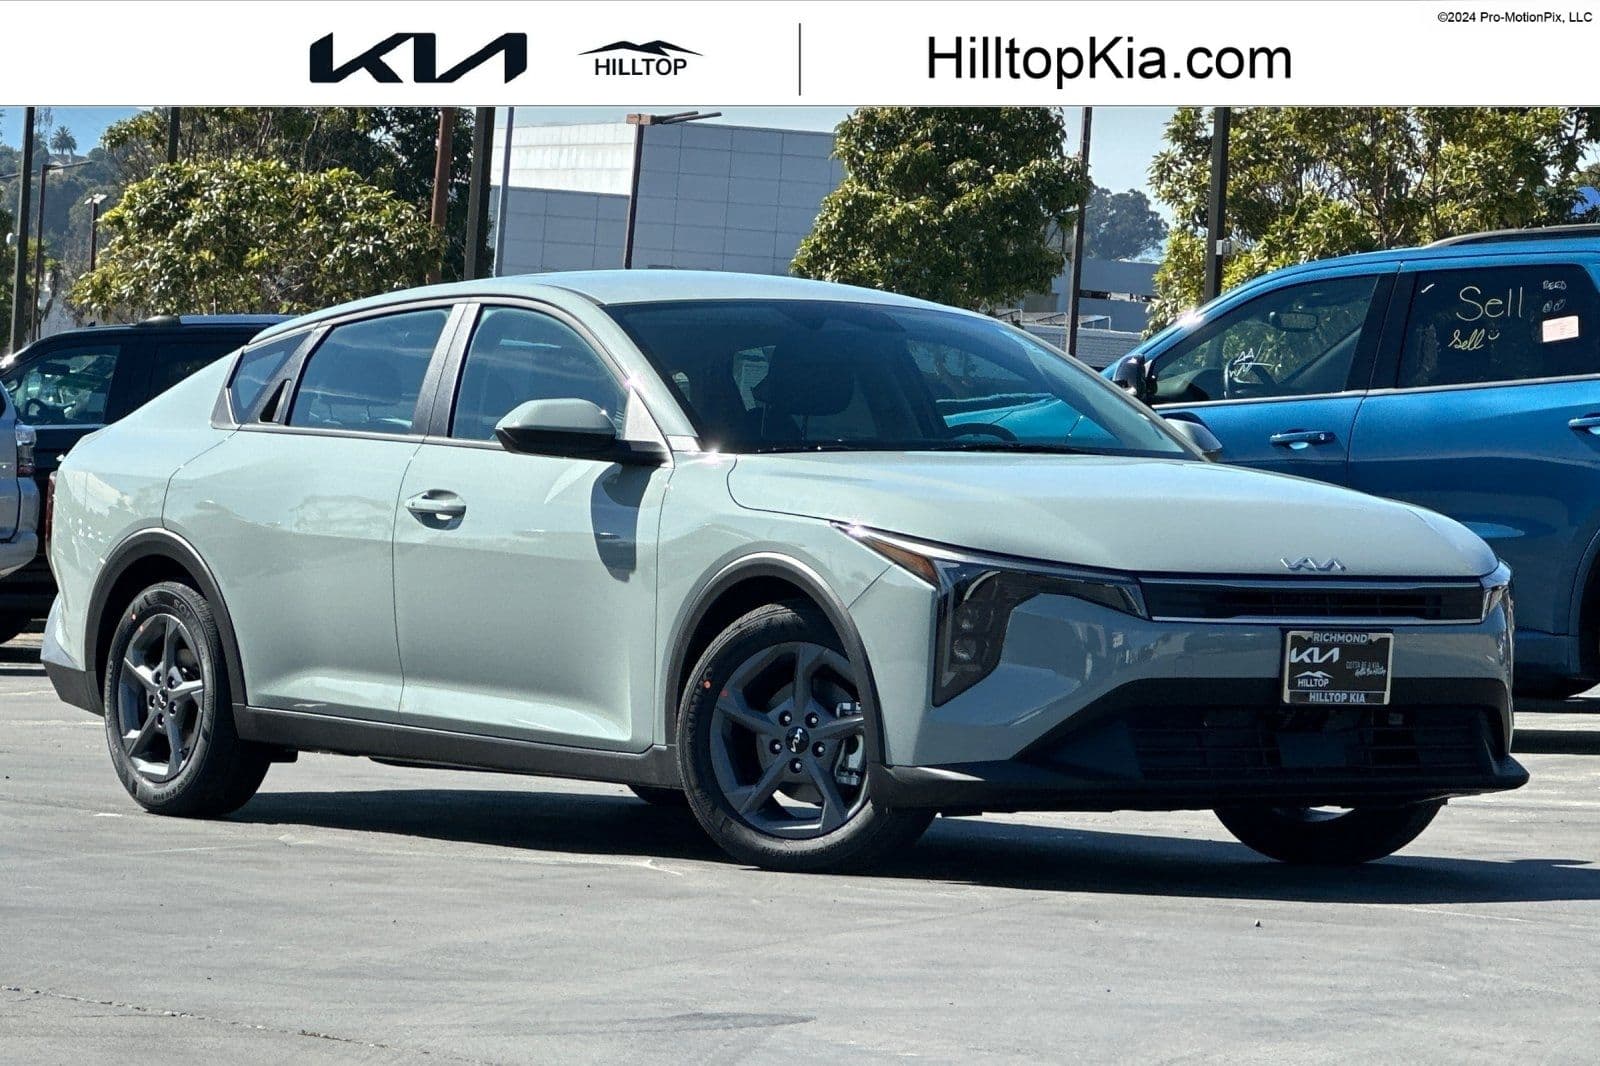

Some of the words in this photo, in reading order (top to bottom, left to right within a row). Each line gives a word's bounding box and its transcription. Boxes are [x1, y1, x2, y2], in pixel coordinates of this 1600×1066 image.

[1456, 285, 1524, 321] Sell
[1313, 633, 1368, 643] RICHMOND
[1297, 679, 1330, 688] HILLTOP
[1309, 692, 1347, 703] HILLTOP
[1349, 693, 1366, 703] KIA
